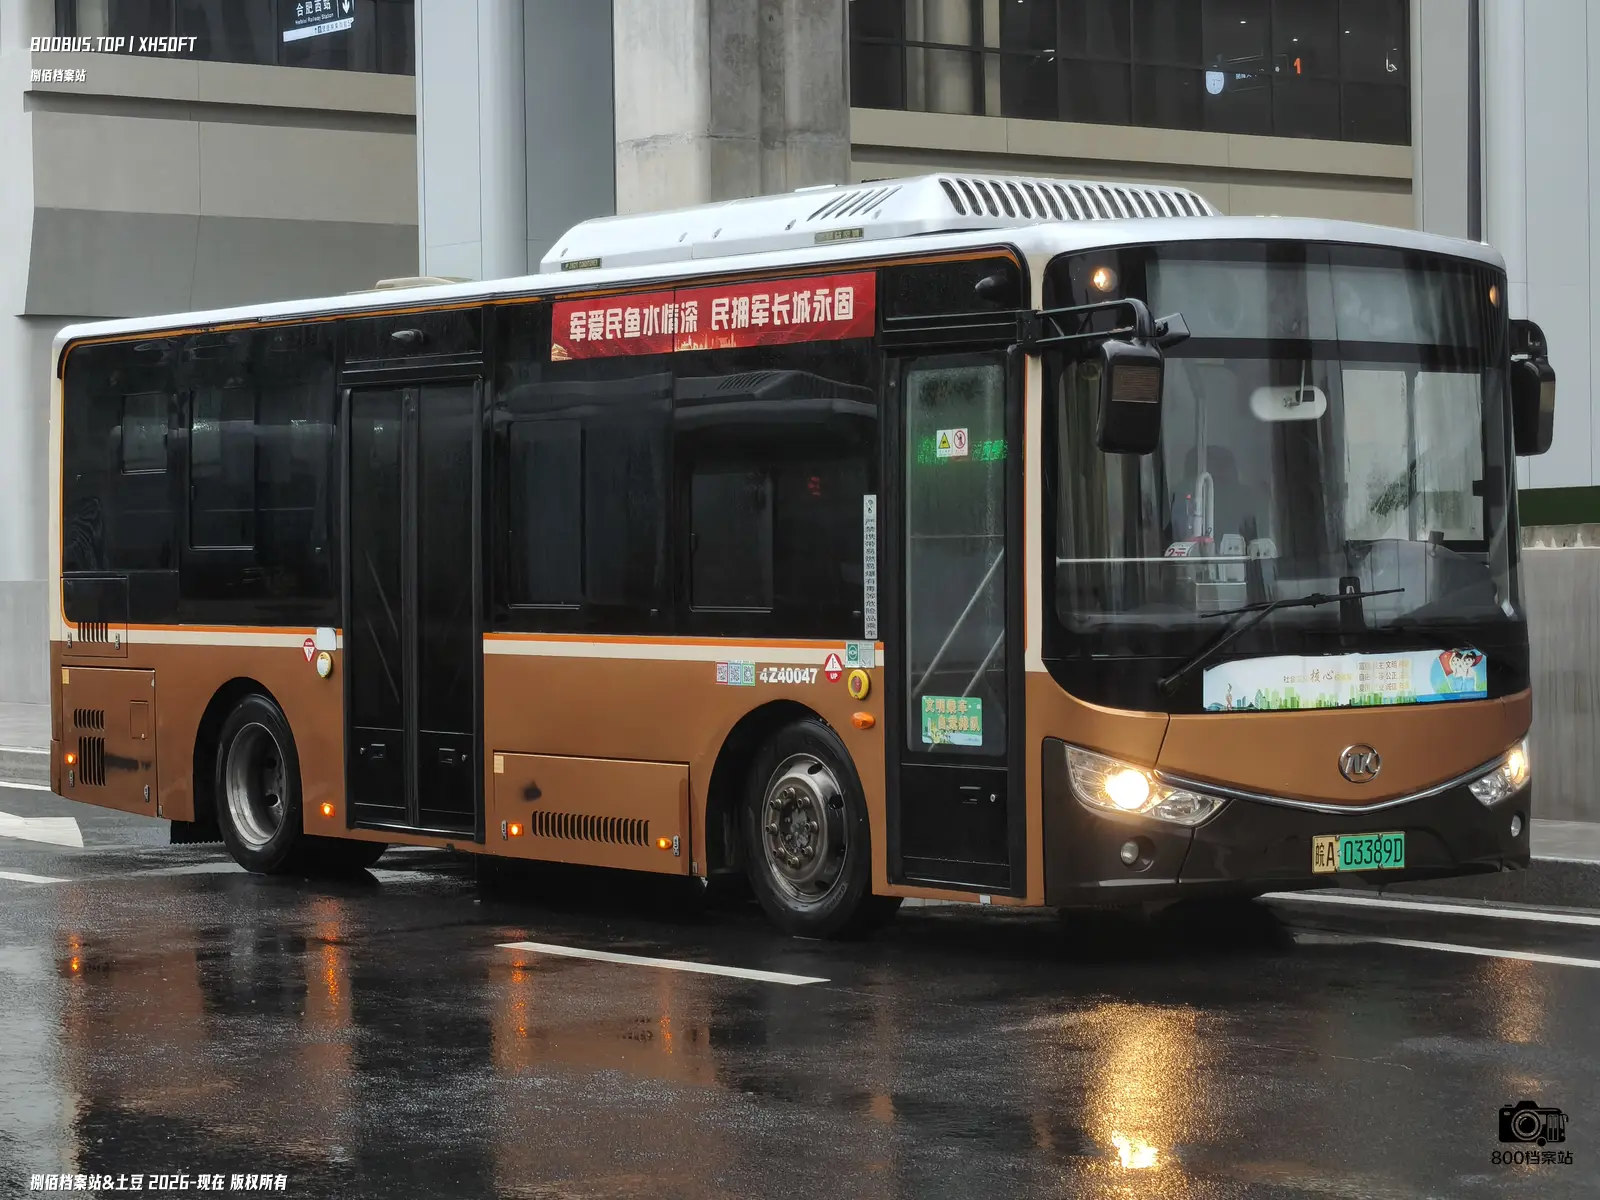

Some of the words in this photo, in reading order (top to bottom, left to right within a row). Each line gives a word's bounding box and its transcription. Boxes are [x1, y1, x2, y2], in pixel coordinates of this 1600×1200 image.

[296, 0, 331, 17] 合肥西站
[569, 301, 698, 342] 军爱民鱼水情深
[711, 286, 854, 331] 民拥军长城永固
[759, 667, 819, 684] 4Z40047
[829, 672, 839, 680] UP
